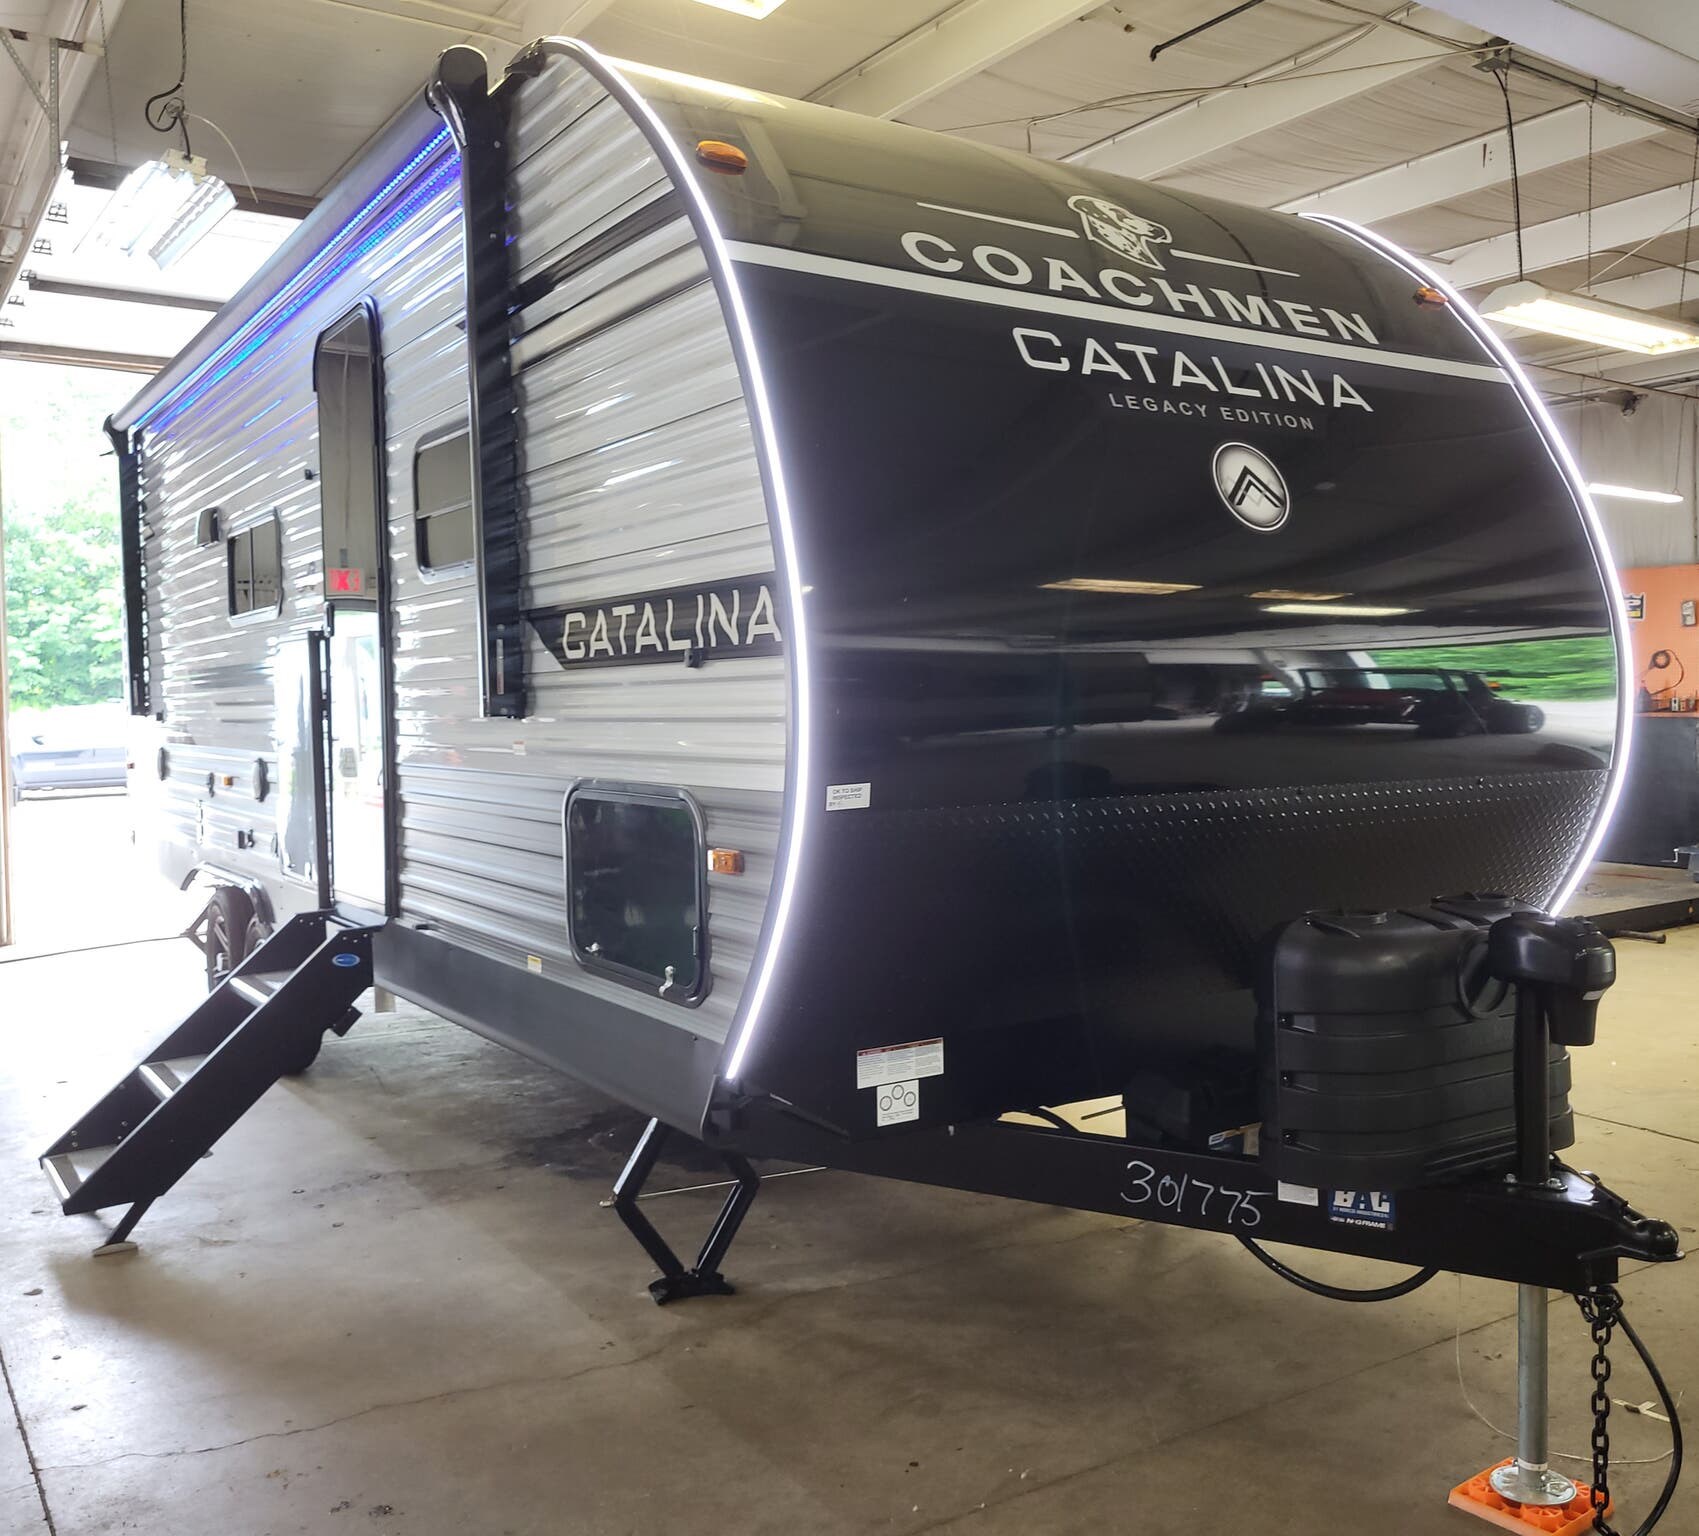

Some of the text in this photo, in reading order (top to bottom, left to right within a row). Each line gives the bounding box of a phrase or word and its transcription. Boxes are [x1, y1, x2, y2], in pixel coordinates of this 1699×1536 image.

[900, 231, 1380, 345] COACHMEN
[1012, 327, 1374, 412] CATALINA
[1108, 393, 1316, 430] LEGACY EDITION
[562, 585, 783, 660] CATALINA
[1120, 1160, 1273, 1226] 301775
